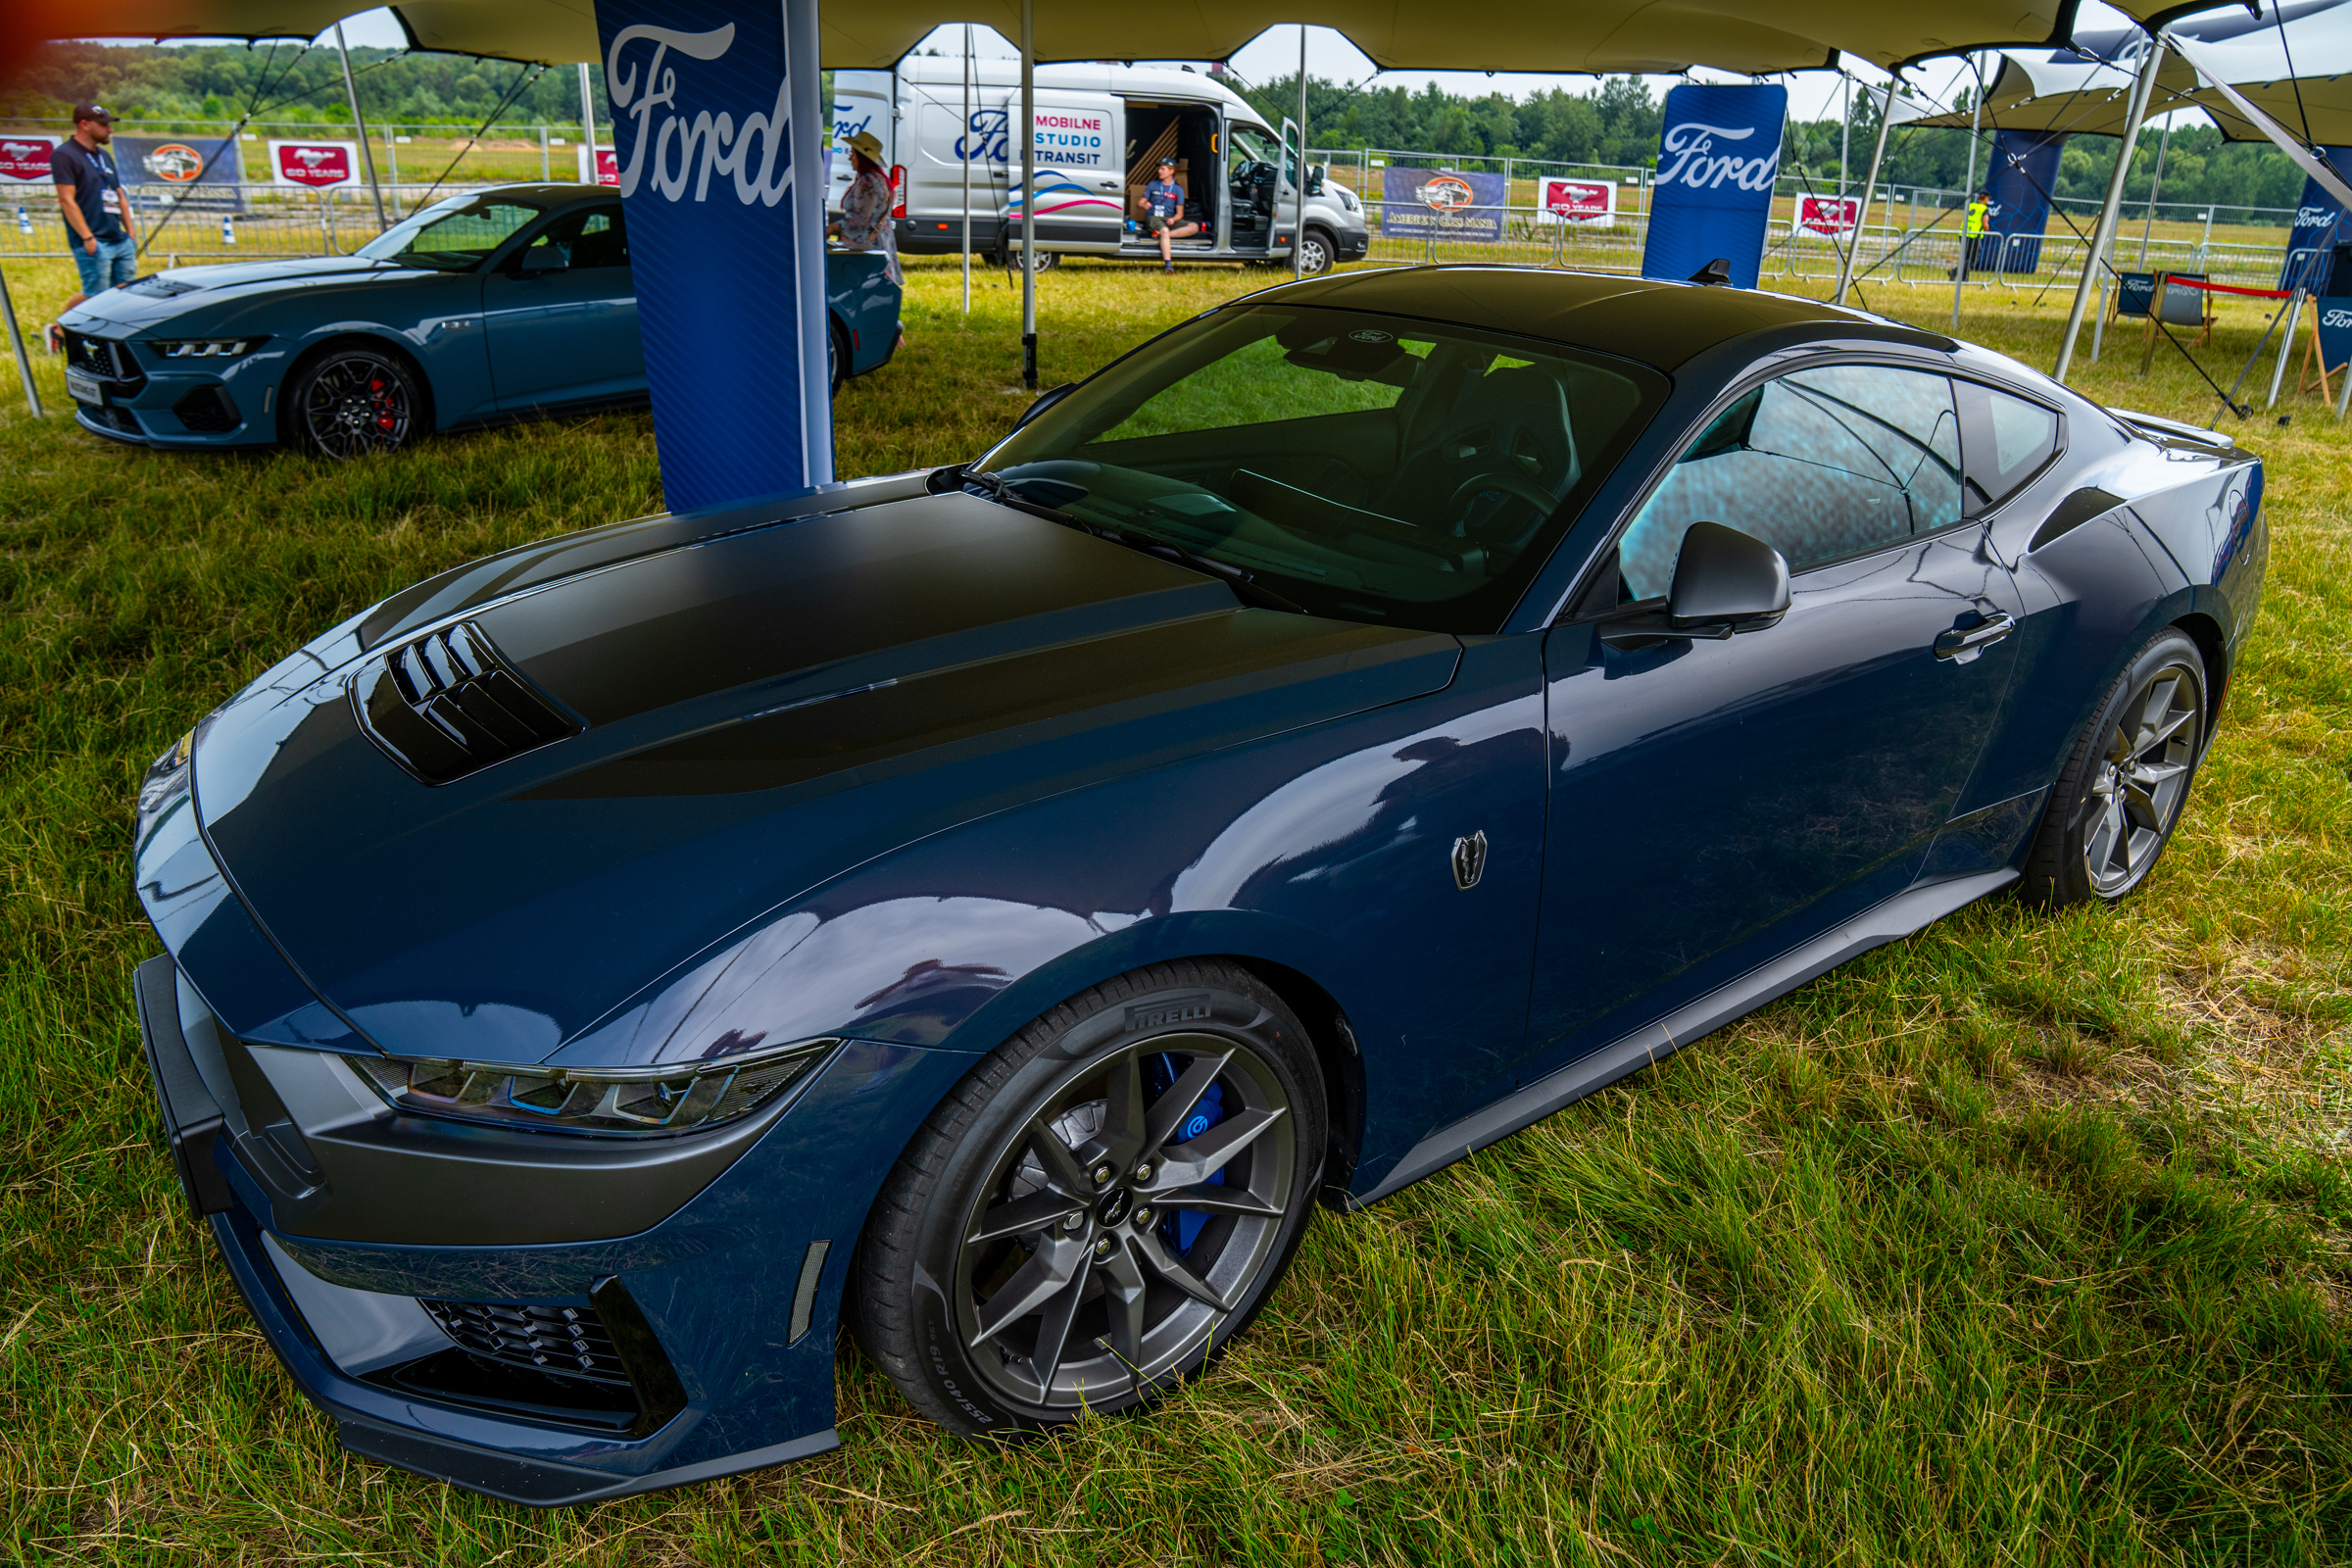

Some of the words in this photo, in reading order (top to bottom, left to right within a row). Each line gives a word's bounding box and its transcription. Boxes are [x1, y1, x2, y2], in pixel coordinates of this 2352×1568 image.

[608, 22, 792, 207] Ford
[1035, 115, 1101, 130] MOBILNE
[1035, 132, 1101, 148] STUDIO
[1020, 150, 1101, 165] TRANSIT
[1655, 122, 1780, 191] Ford
[308, 169, 345, 177] YEARS
[1464, 217, 1497, 229] MANIA
[2294, 206, 2336, 227] Ford
[2124, 278, 2155, 292] Ford
[2322, 309, 2352, 328] For
[1124, 993, 1211, 1032] PIRELLI
[929, 1346, 949, 1375] R19
[943, 1379, 994, 1424] 255/40
